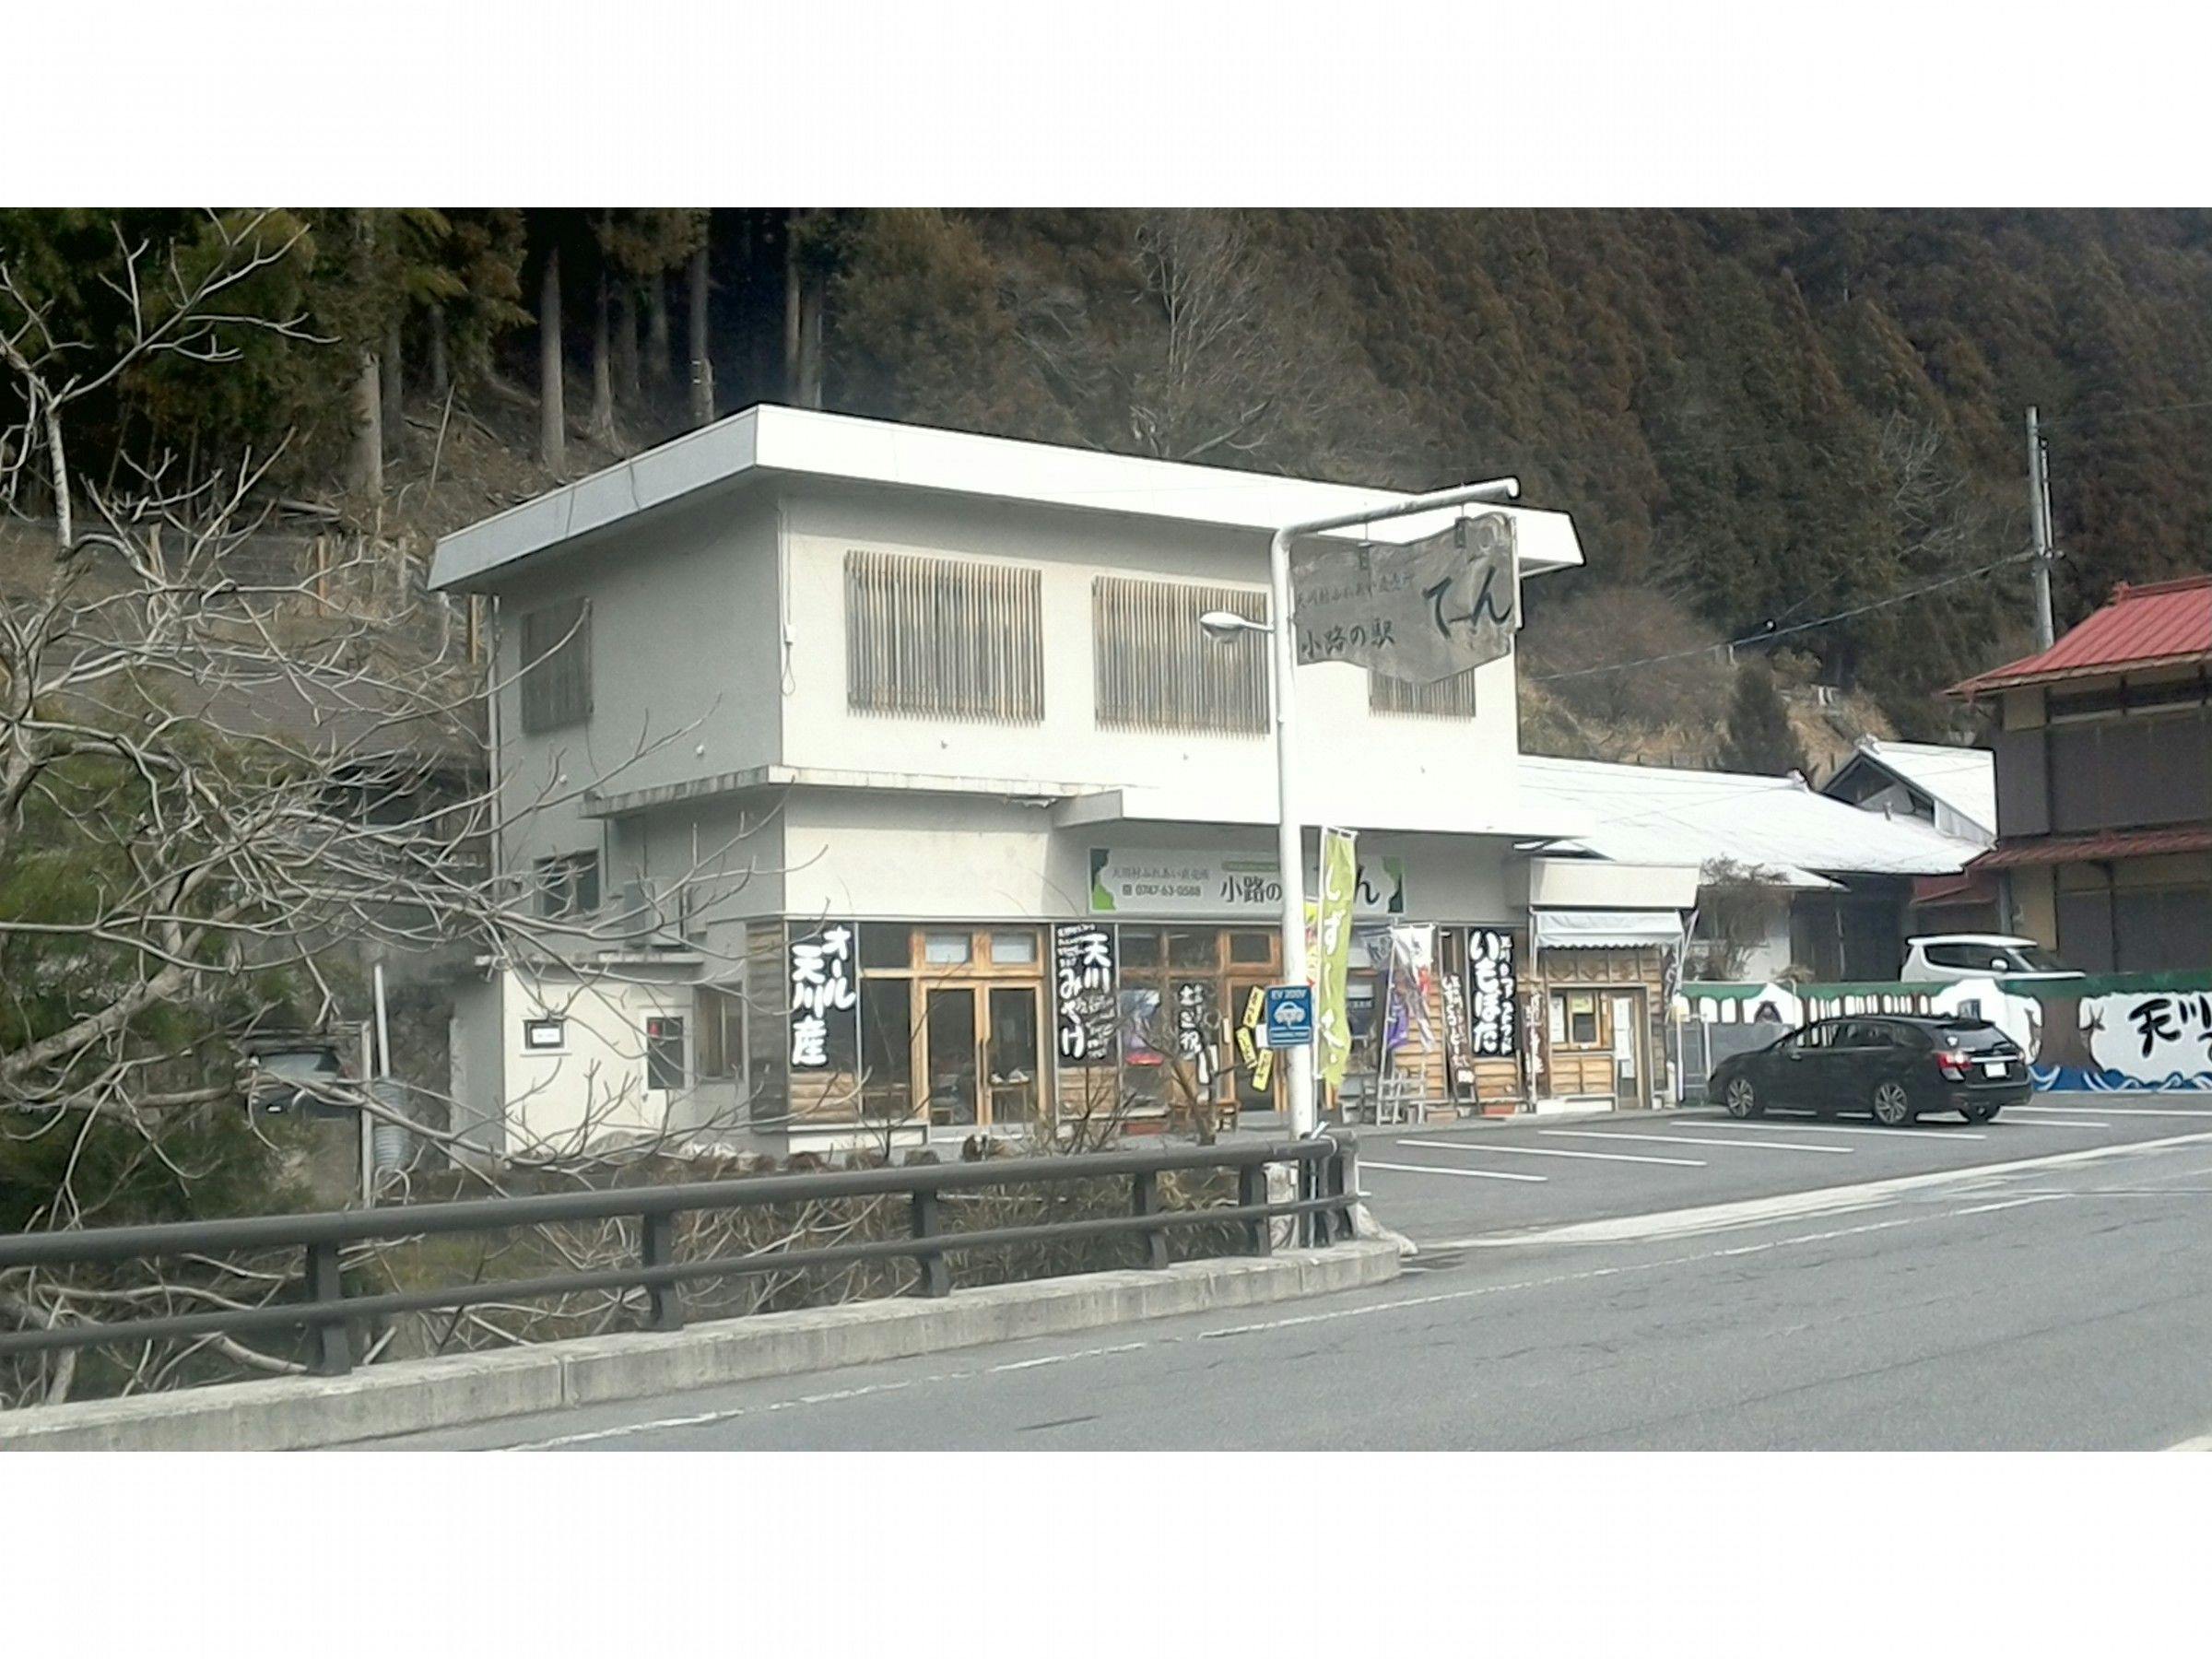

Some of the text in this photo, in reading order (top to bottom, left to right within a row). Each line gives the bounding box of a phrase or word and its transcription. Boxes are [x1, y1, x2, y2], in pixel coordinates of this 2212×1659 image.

[792, 944, 828, 1065] 天川産
[1083, 933, 1112, 994] 天川
